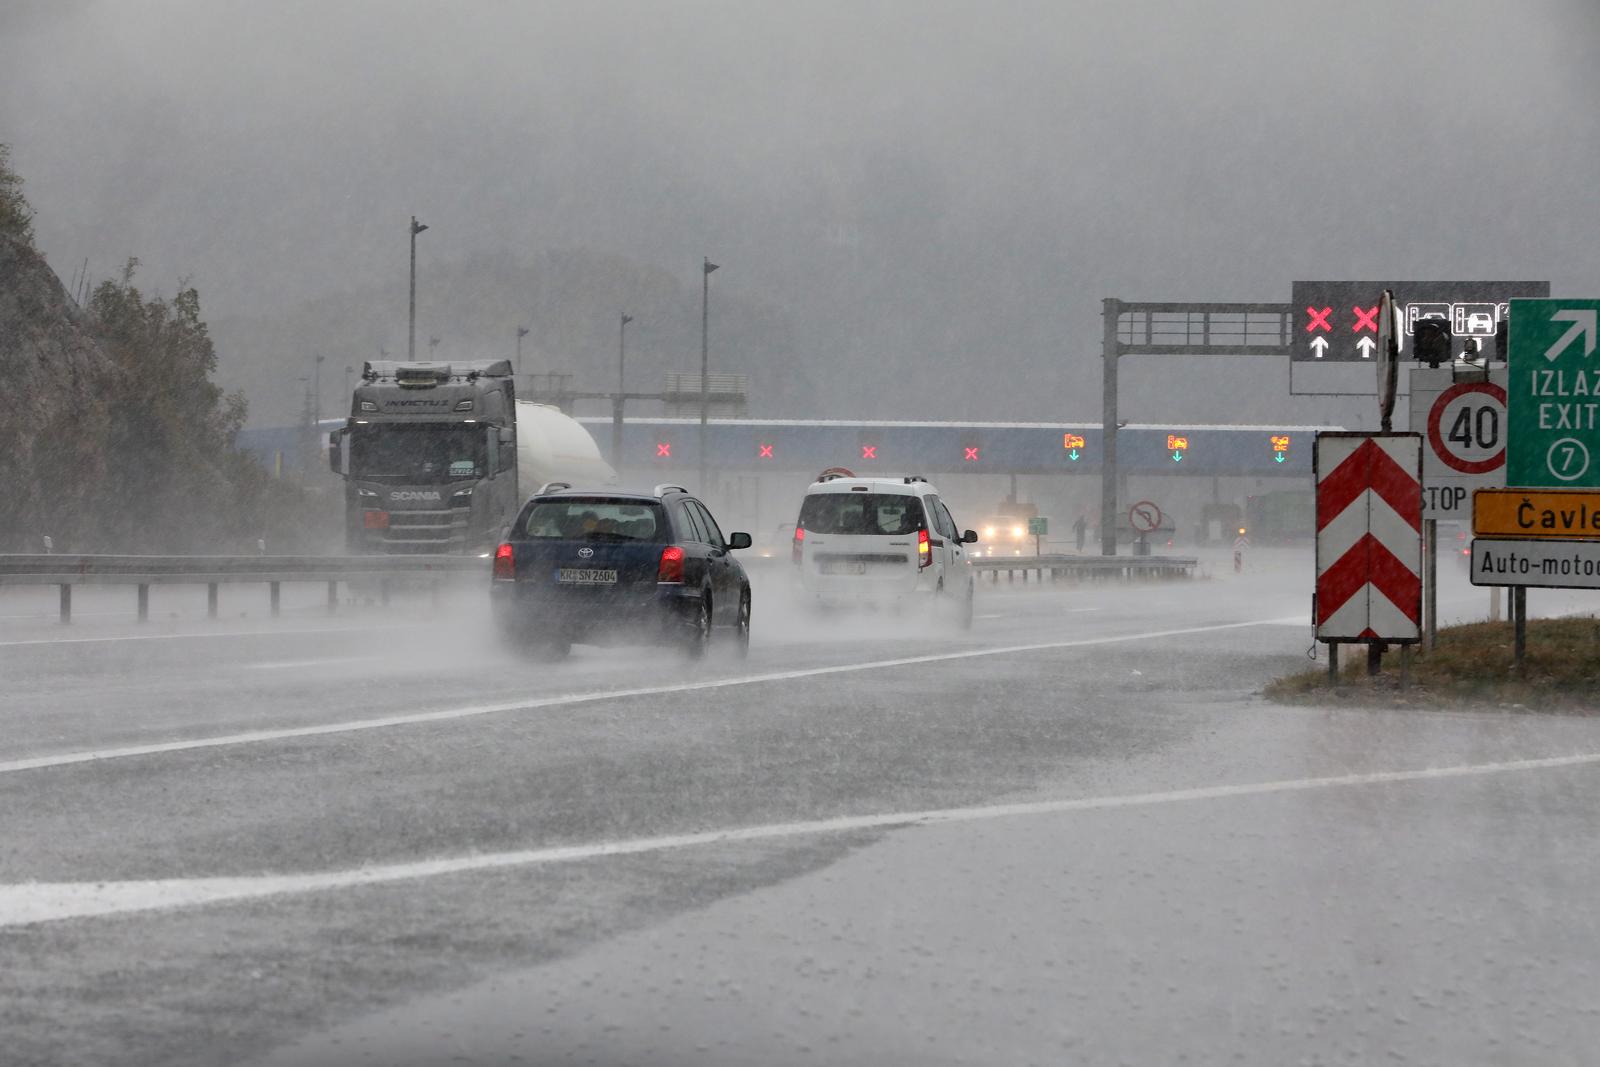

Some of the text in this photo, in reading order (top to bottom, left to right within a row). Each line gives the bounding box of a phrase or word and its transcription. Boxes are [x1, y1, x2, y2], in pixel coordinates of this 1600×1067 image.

[1448, 406, 1499, 449] 40
[1538, 403, 1599, 430] EXIT
[1561, 447, 1575, 472] 7
[390, 491, 441, 501] SCANIA
[578, 570, 591, 581] SN
[593, 570, 616, 582] 2604
